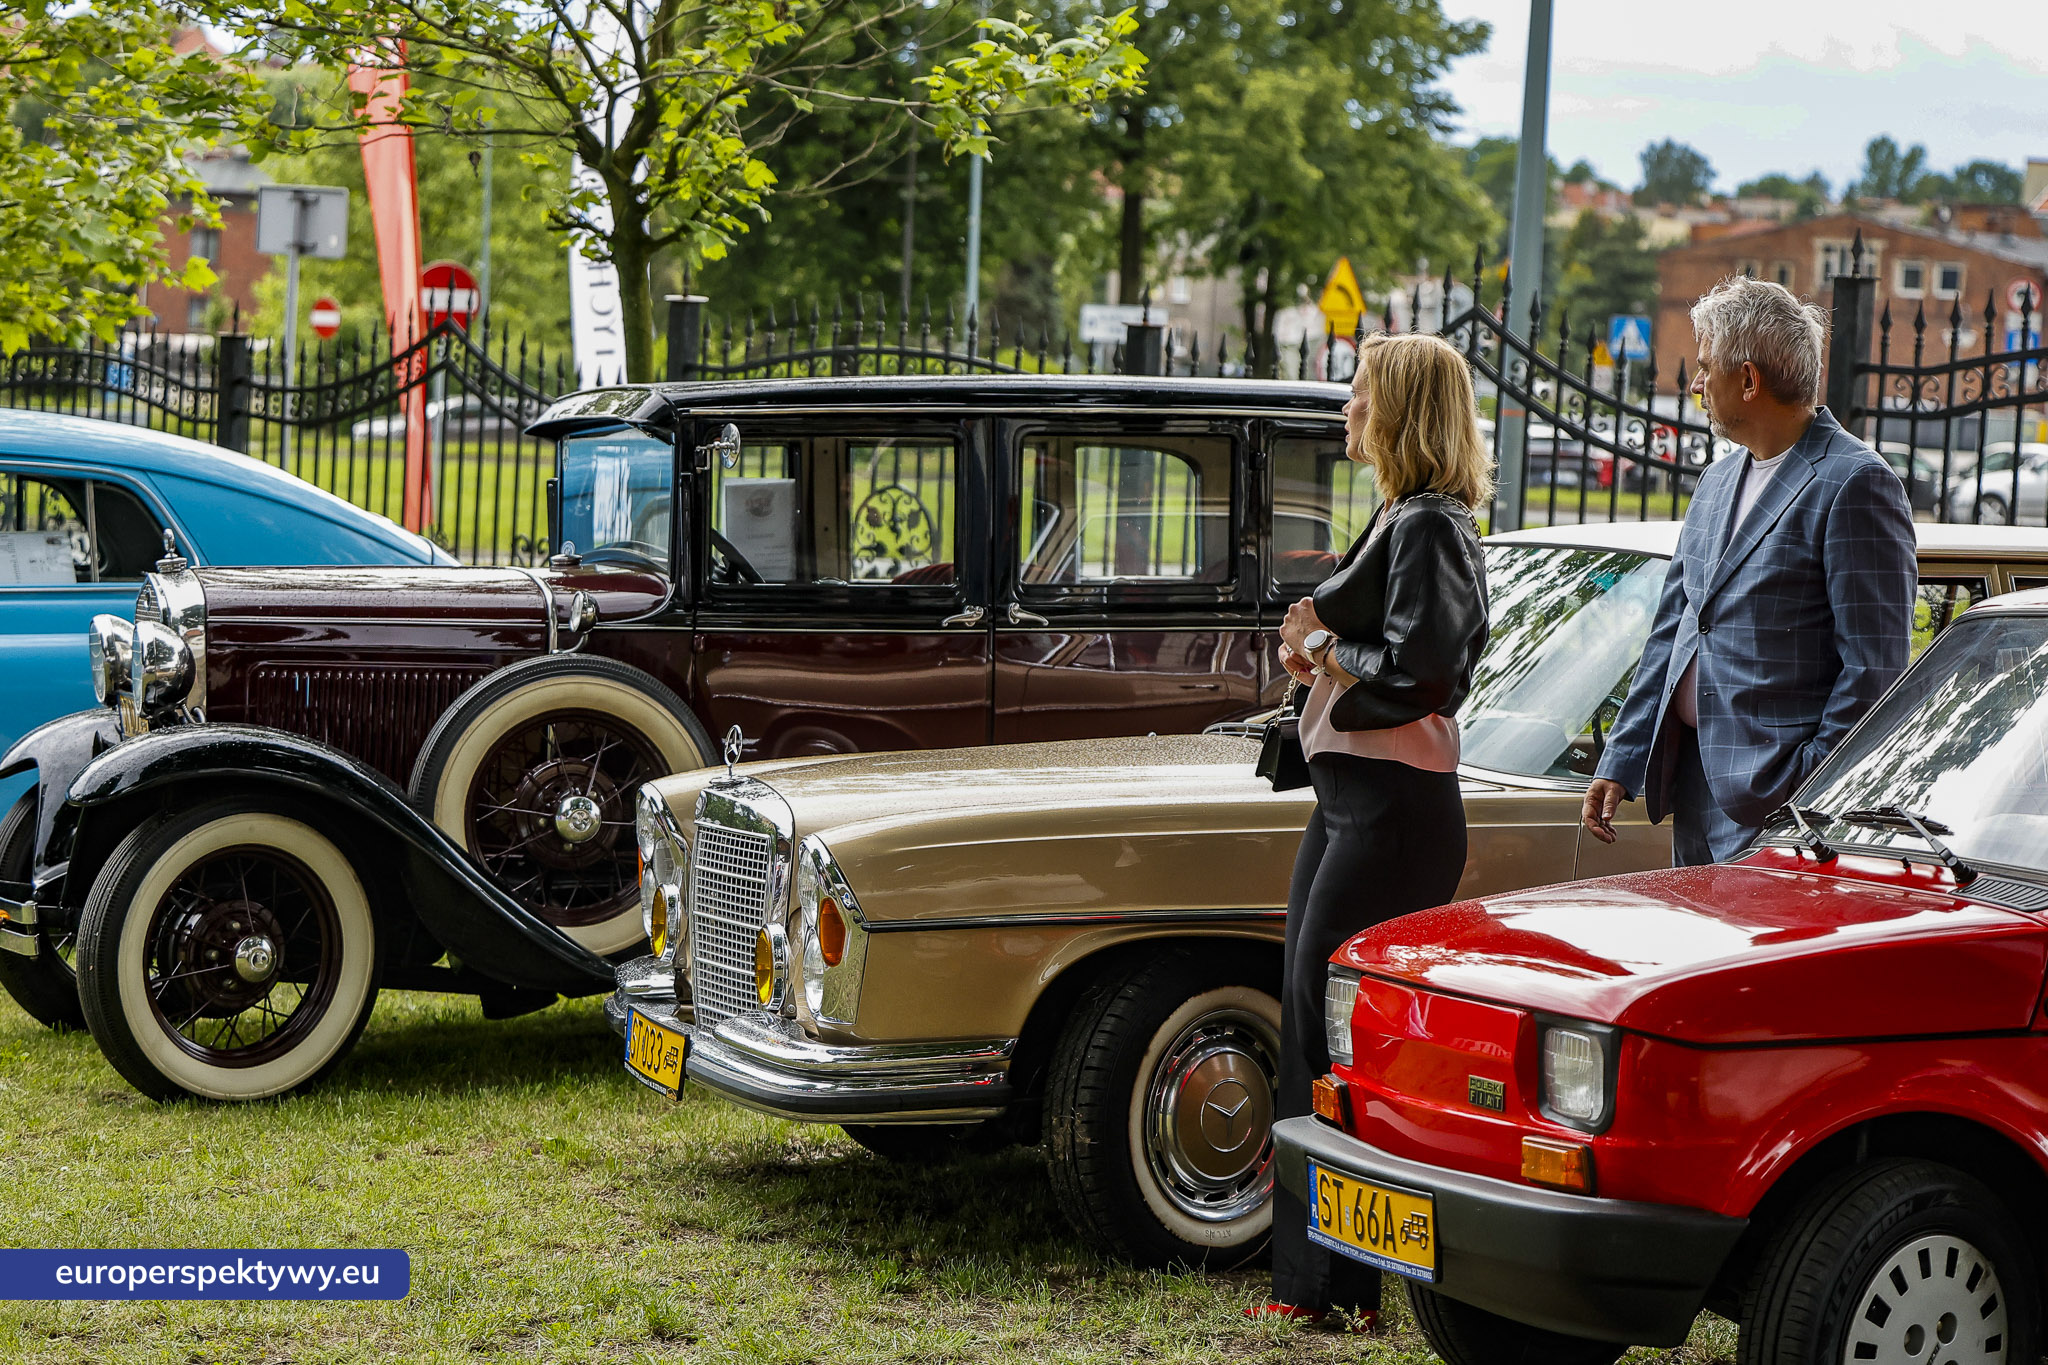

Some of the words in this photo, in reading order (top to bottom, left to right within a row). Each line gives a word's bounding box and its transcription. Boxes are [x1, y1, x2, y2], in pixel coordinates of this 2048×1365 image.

[632, 1017, 644, 1062] ST
[642, 1025, 664, 1073] 033
[1470, 1077, 1503, 1095] POLSKI
[1470, 1090, 1501, 1109] FIAT
[1311, 1203, 1319, 1219] PL
[1319, 1173, 1344, 1235] ST
[1353, 1187, 1398, 1254] 66A
